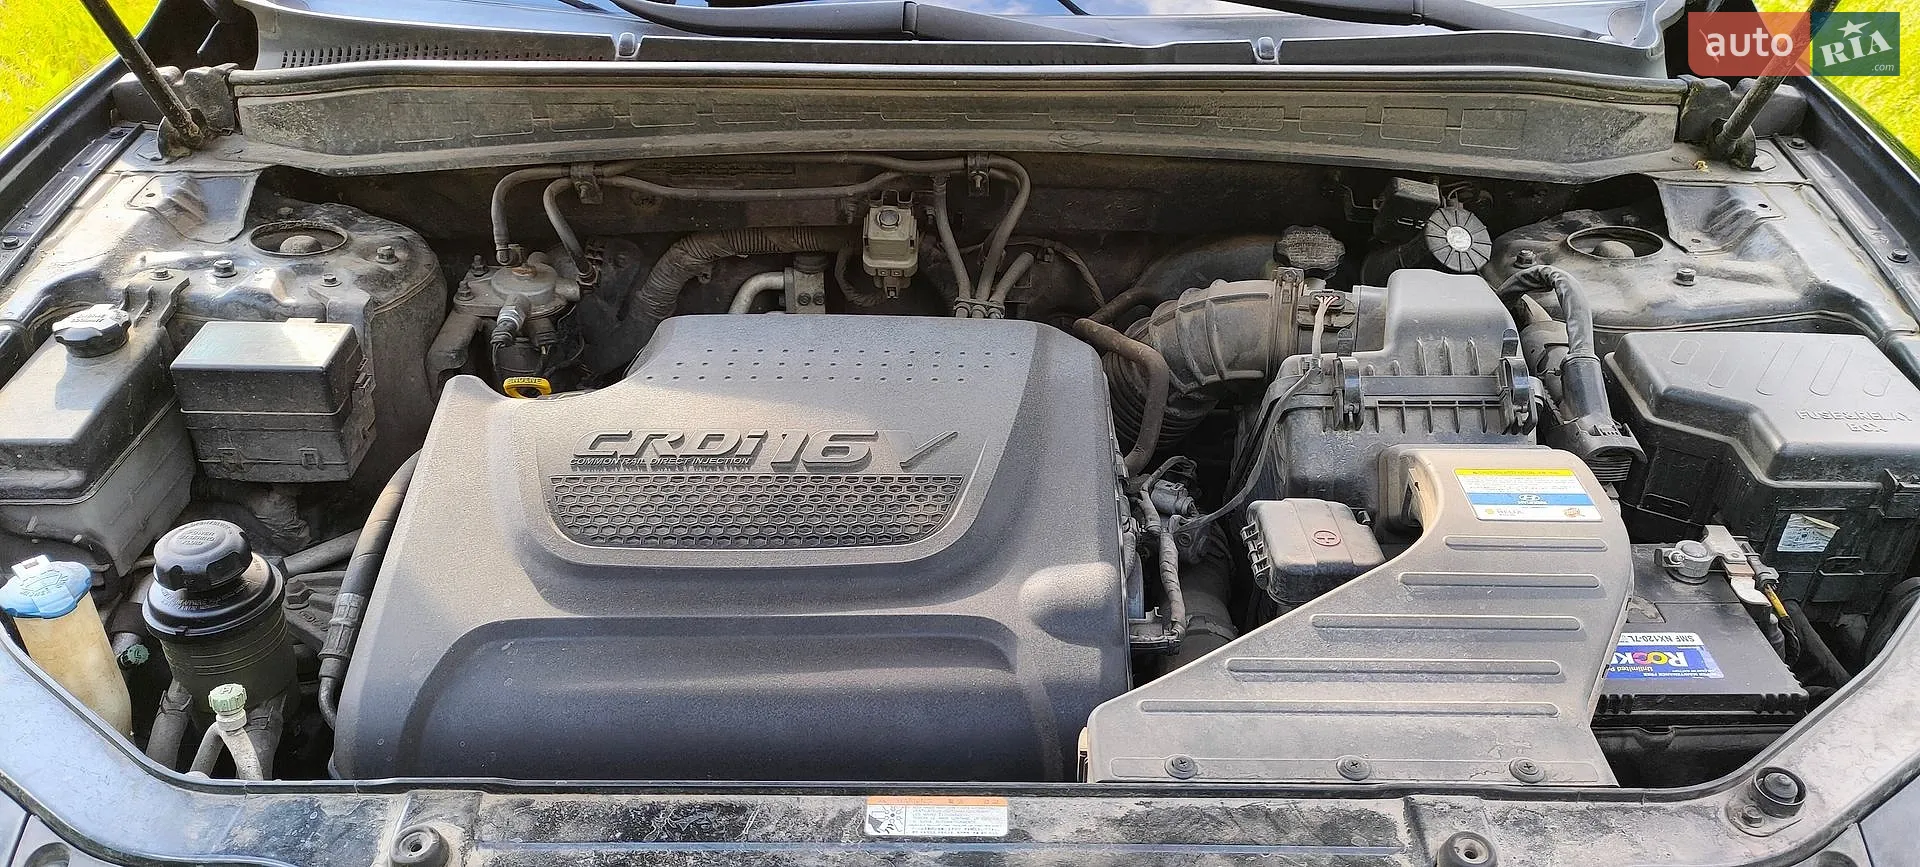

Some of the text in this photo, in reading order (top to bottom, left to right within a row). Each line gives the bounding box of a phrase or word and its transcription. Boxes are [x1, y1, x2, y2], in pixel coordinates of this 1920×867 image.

[570, 457, 751, 465] COMMON RAIL DIRECT INJECTION
